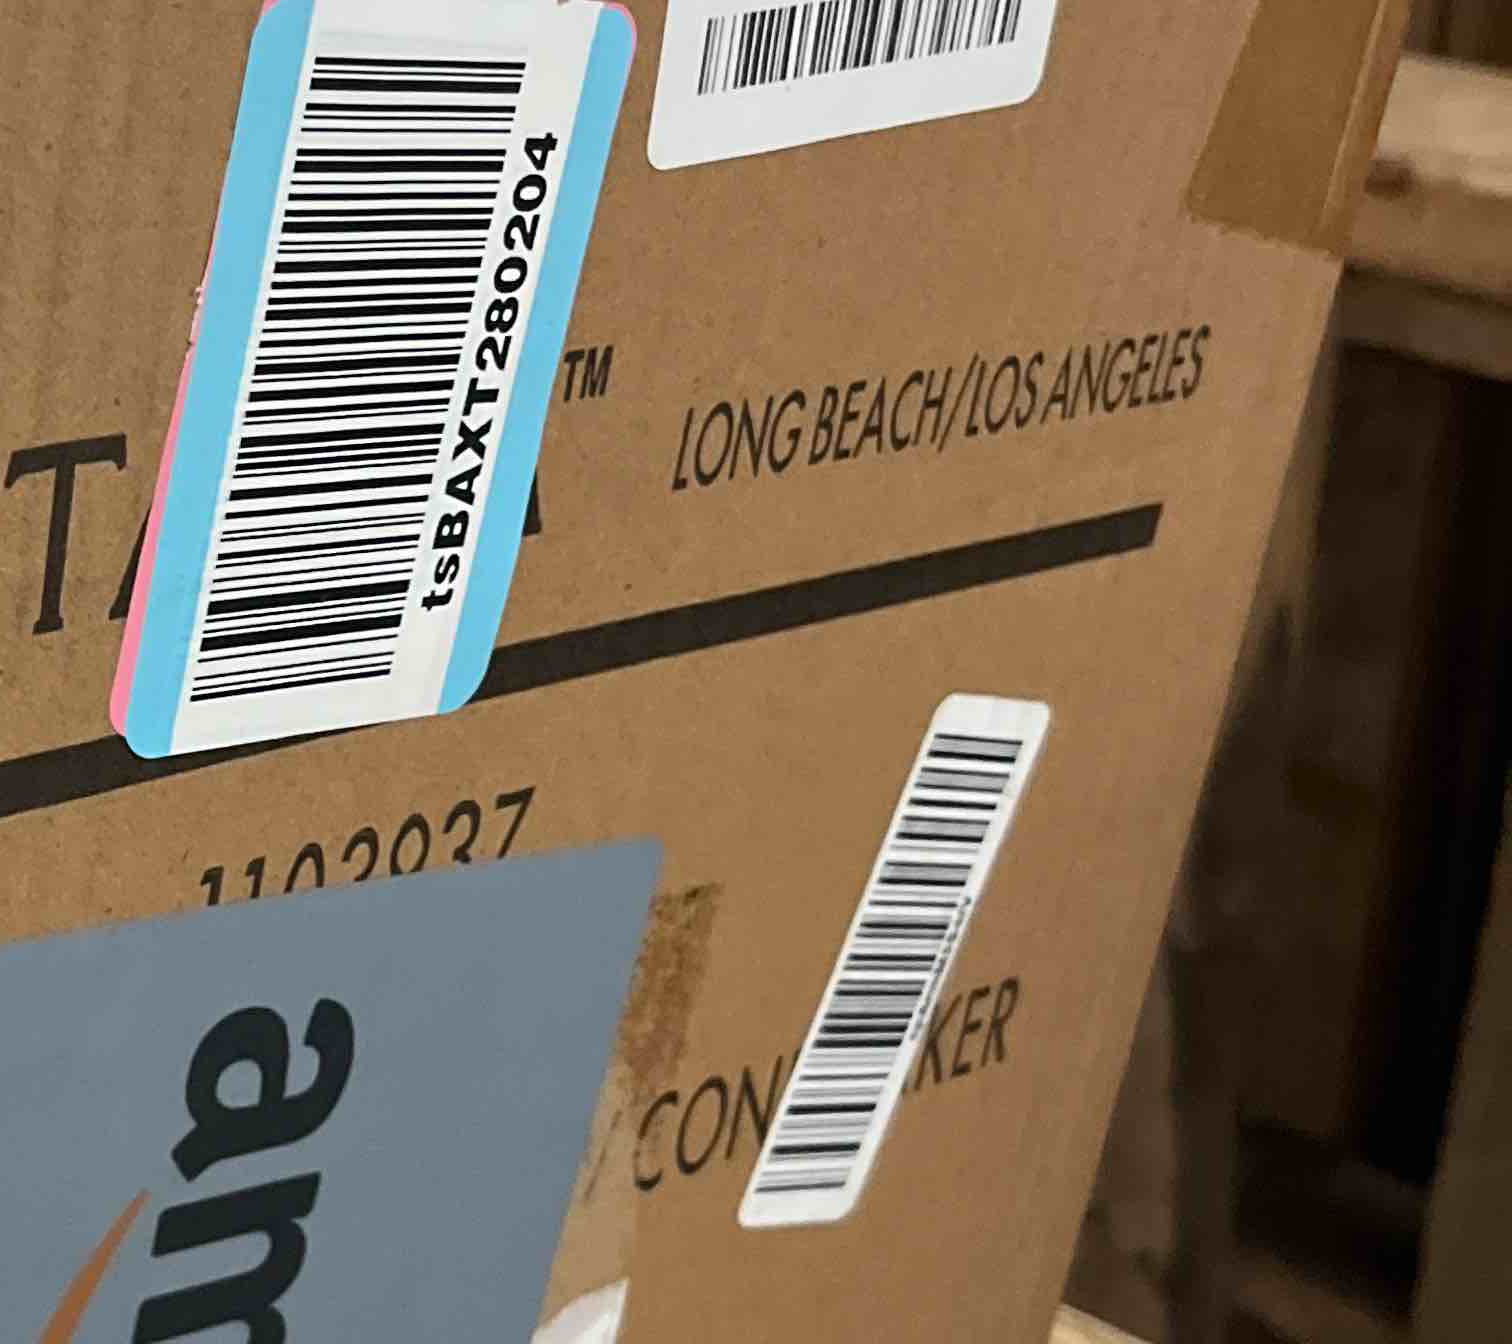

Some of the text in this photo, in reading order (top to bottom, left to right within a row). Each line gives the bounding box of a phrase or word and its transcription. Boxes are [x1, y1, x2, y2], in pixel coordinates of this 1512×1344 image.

[420, 131, 559, 613] tsBAXT280204
[671, 388, 807, 491] LONG
[1040, 324, 1212, 424] ANGELES
[634, 1048, 801, 1192] CON
